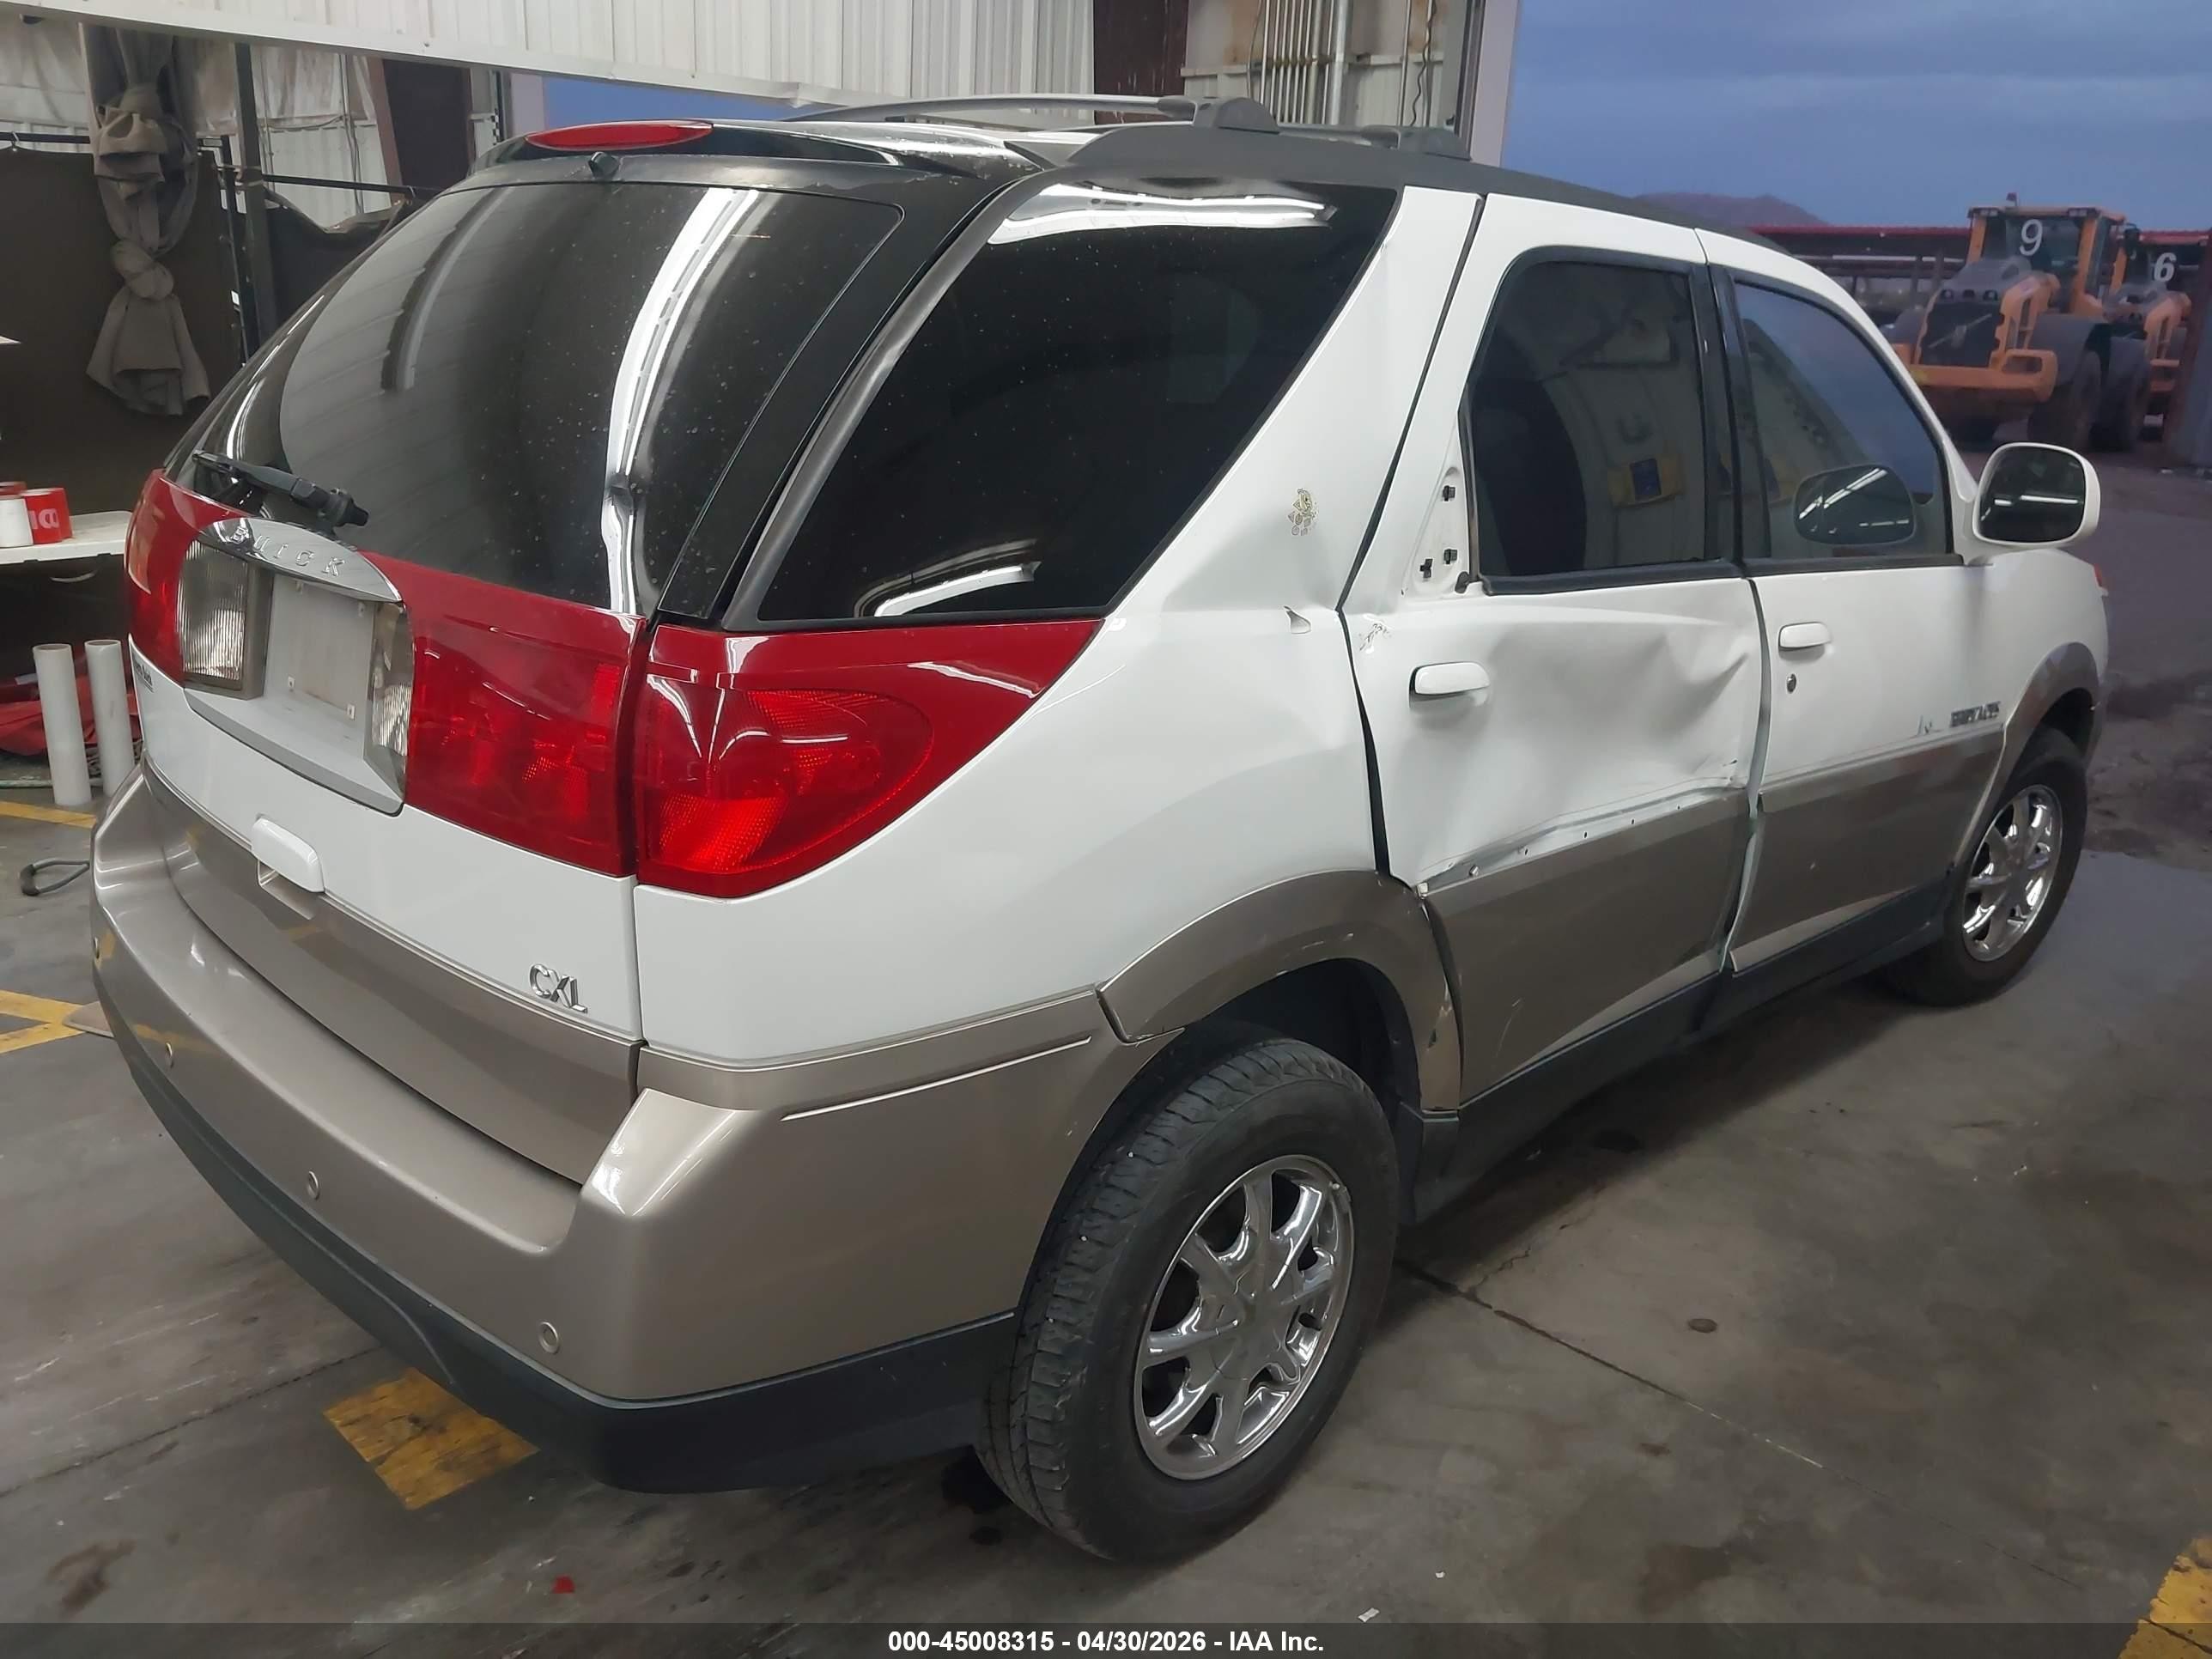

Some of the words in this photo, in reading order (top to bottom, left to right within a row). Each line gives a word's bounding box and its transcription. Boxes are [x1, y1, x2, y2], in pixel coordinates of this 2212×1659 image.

[2019, 218, 2043, 256] 9
[2154, 252, 2177, 283] 6
[230, 526, 345, 577] BUICK
[529, 963, 588, 1014] CXL
